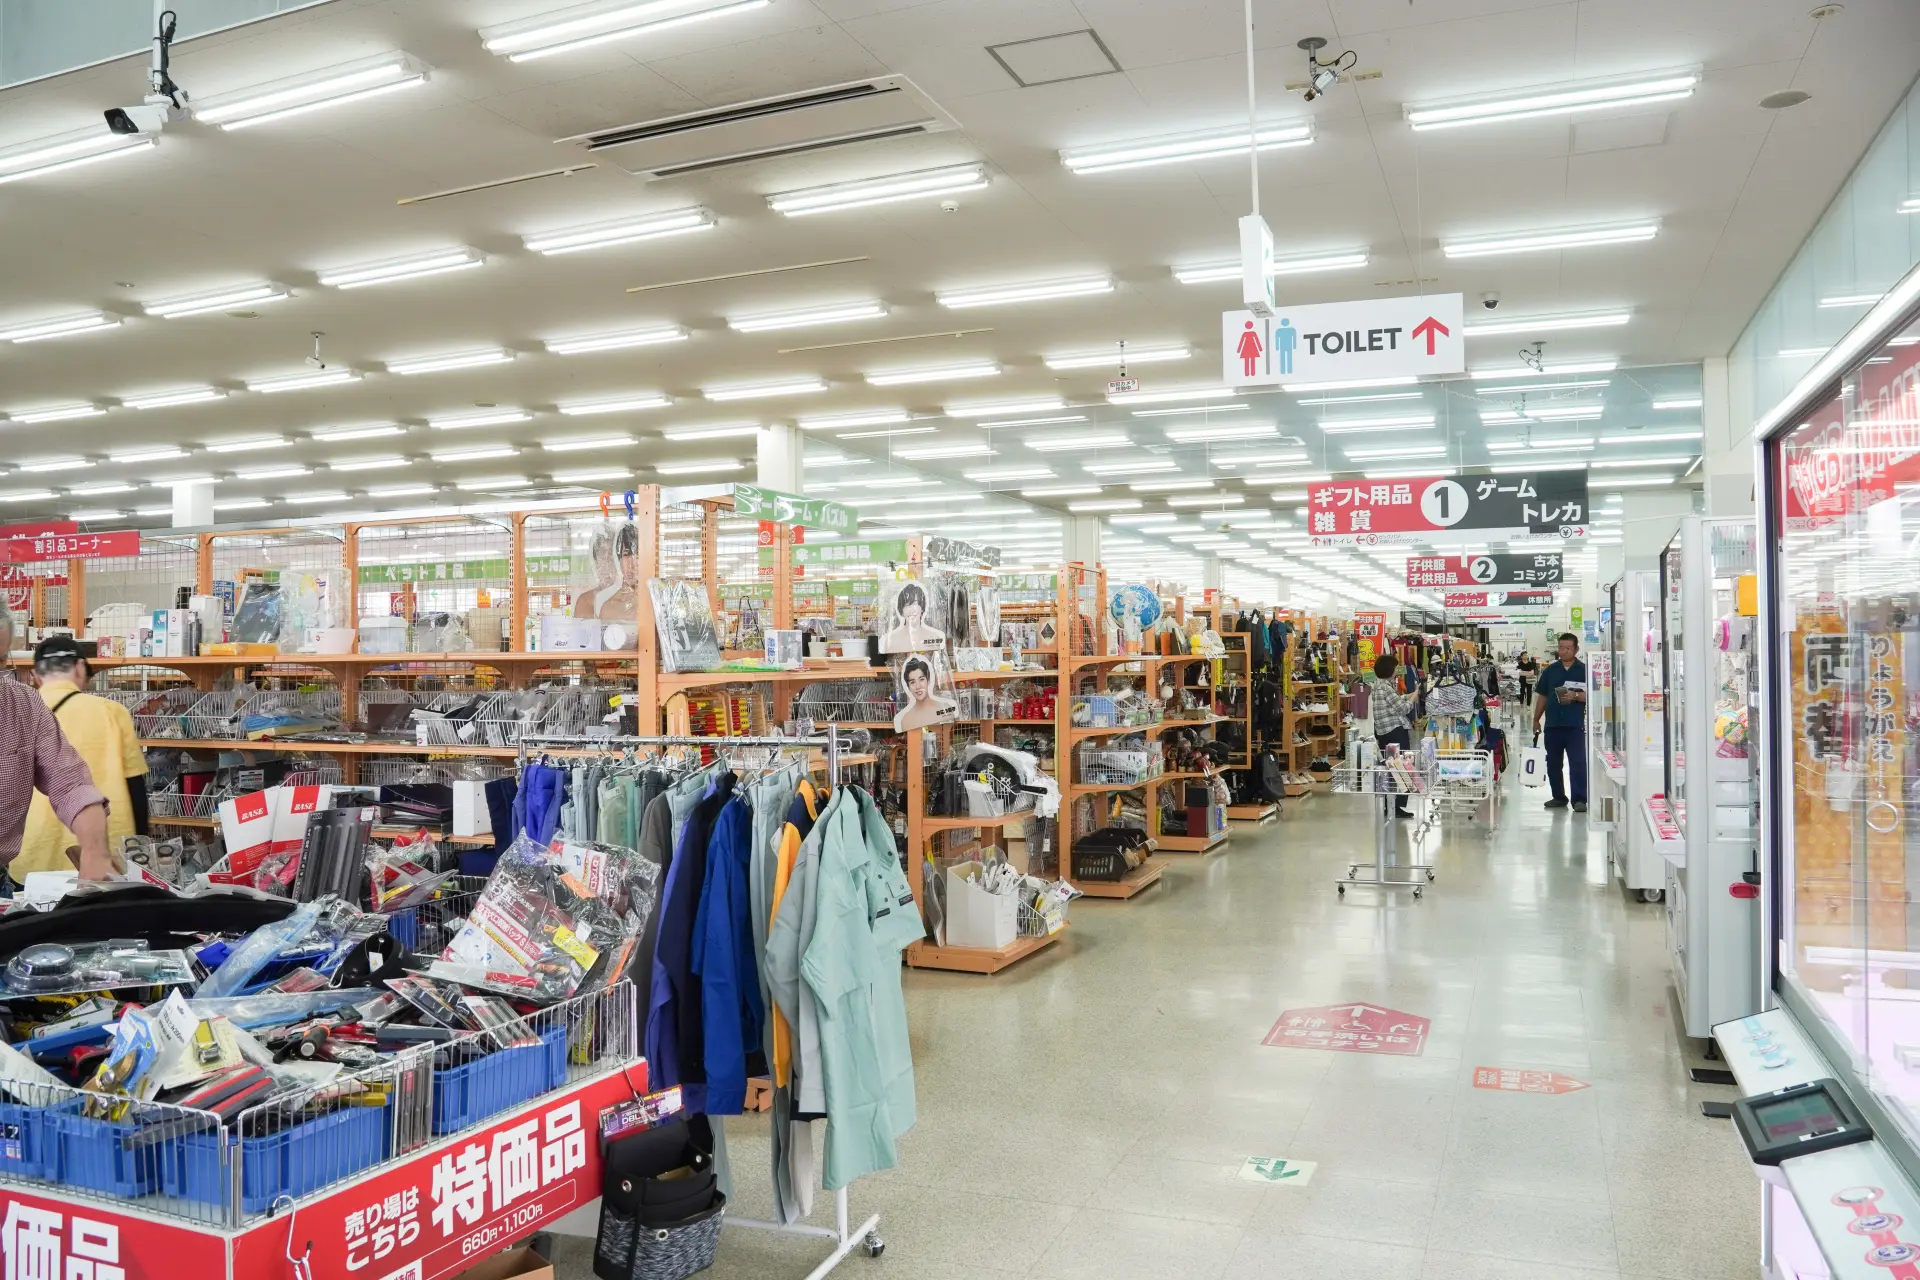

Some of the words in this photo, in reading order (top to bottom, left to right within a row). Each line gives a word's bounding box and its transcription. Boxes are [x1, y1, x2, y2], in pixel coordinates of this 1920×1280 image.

[1303, 327, 1402, 355] TOILET
[1314, 484, 1412, 507] ギフト用品
[1476, 479, 1538, 501] ゲーム
[1433, 486, 1449, 519] 1
[1314, 510, 1371, 532] 雑貨
[1523, 502, 1581, 523] トレカ
[34, 536, 112, 554] 割引品コーナー
[1409, 559, 1445, 572] 子供服
[1476, 560, 1491, 579] 2
[1533, 555, 1559, 567] 古本
[385, 564, 465, 582] ペット用品
[1409, 572, 1458, 585] 子供用品
[1513, 568, 1559, 581] コミック
[1446, 598, 1484, 606] ファッション
[1528, 596, 1552, 604] 休憩所
[1868, 634, 1896, 763] りょうがえ
[241, 807, 265, 821] BASE
[293, 802, 314, 812] BASE
[1284, 1028, 1411, 1044] お手洗いは
[1305, 1038, 1381, 1049] コチラ
[430, 1099, 587, 1238] 特価品
[344, 1185, 421, 1240] 売り場は
[345, 1211, 422, 1272] こちら
